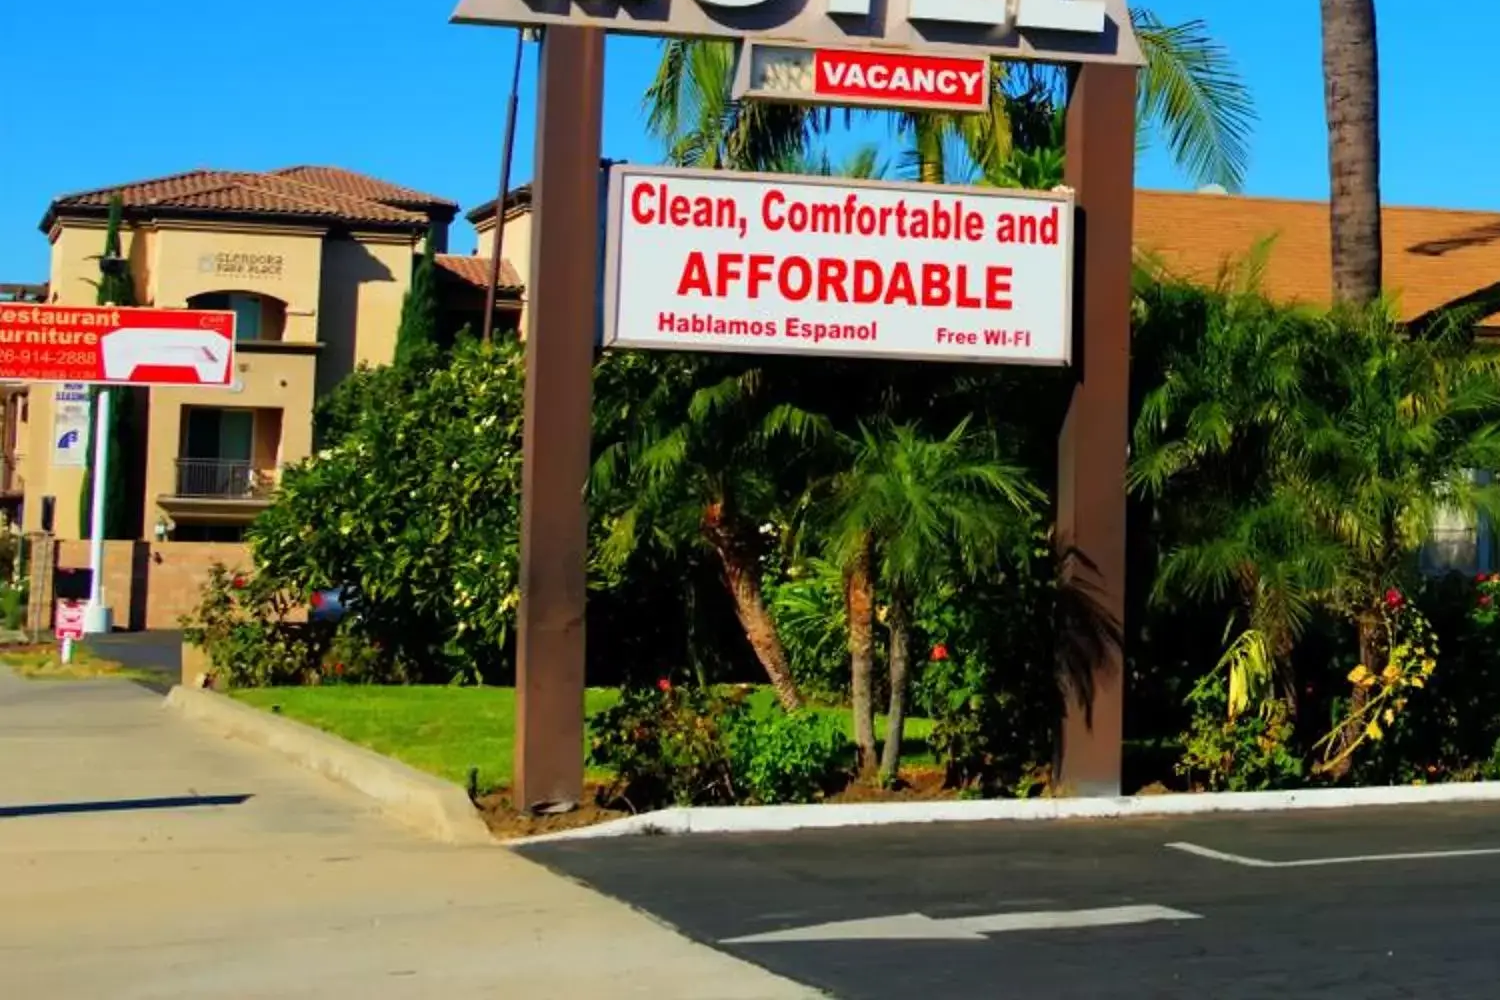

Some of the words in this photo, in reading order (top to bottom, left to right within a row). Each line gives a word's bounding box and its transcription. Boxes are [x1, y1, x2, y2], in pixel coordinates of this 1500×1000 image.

[823, 61, 980, 96] VACANCY
[630, 181, 748, 238] Clean,
[760, 188, 986, 242] Comfortable
[995, 206, 1060, 246] and
[676, 250, 1015, 311] AFFORDABLE
[0, 307, 120, 326] estaurant
[657, 312, 777, 338] Hablamos
[784, 317, 878, 343] Espanol
[936, 327, 978, 345] Free
